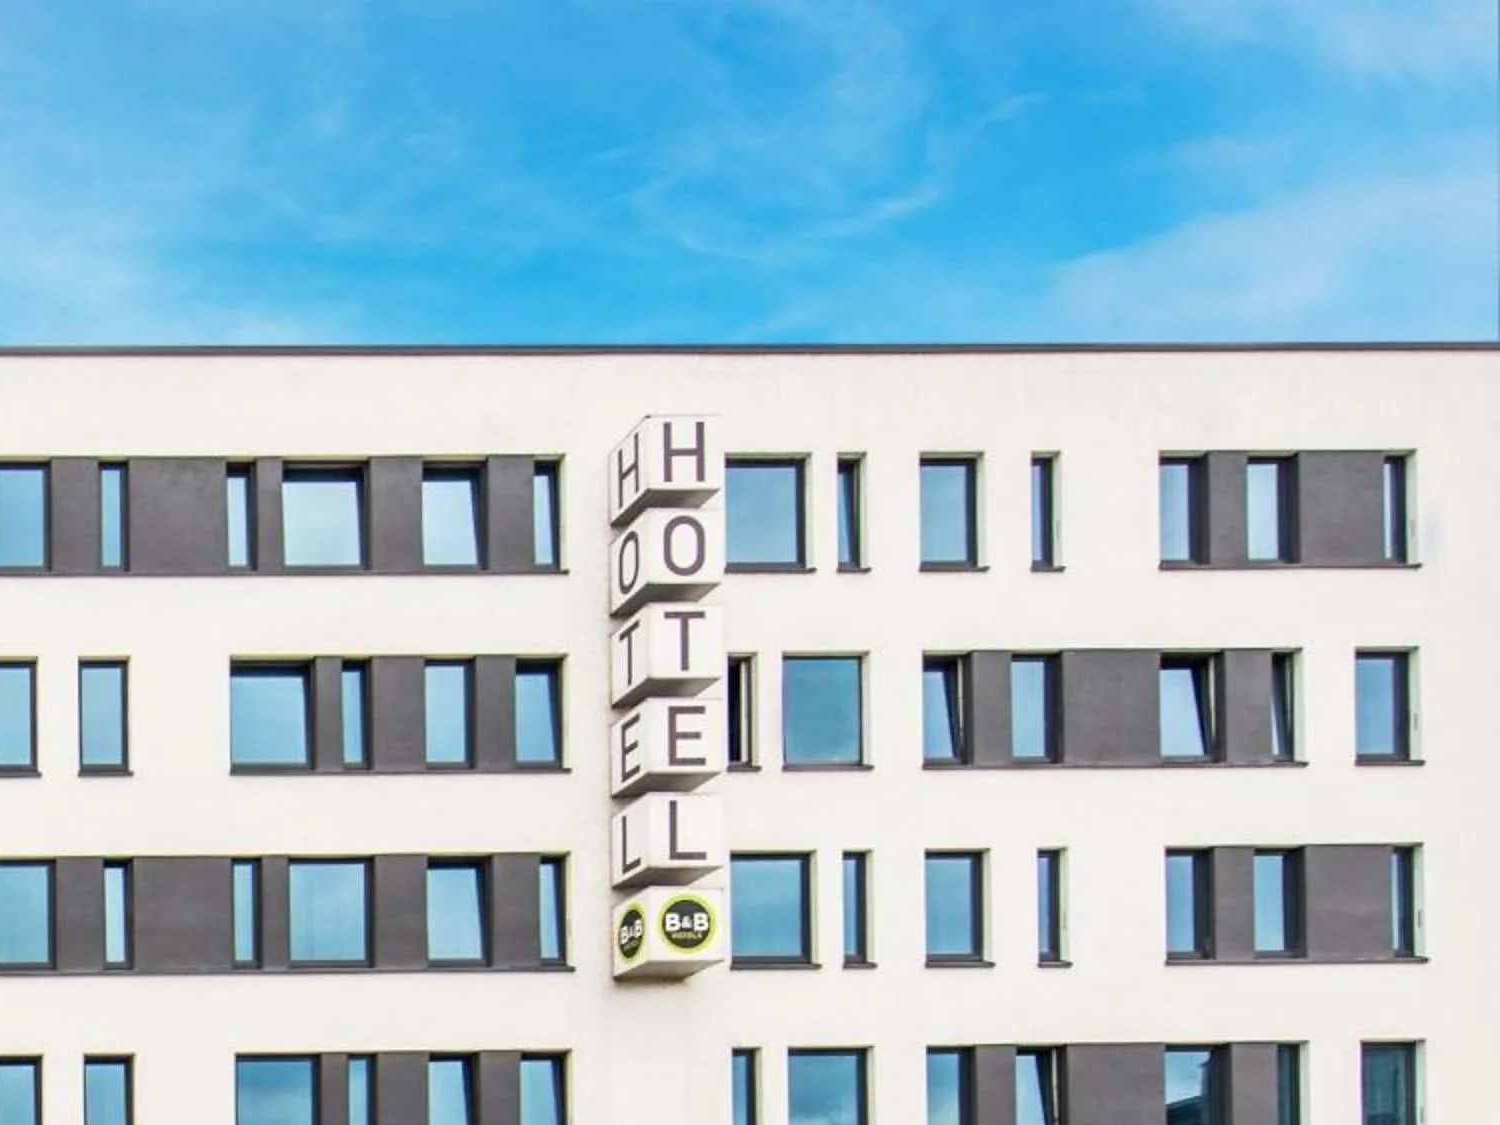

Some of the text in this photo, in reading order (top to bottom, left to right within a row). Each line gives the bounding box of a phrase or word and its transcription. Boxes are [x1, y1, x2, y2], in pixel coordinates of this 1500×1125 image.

[617, 432, 641, 874] HOTELL
[663, 421, 707, 861] HOTELL
[665, 912, 709, 932] B&B
